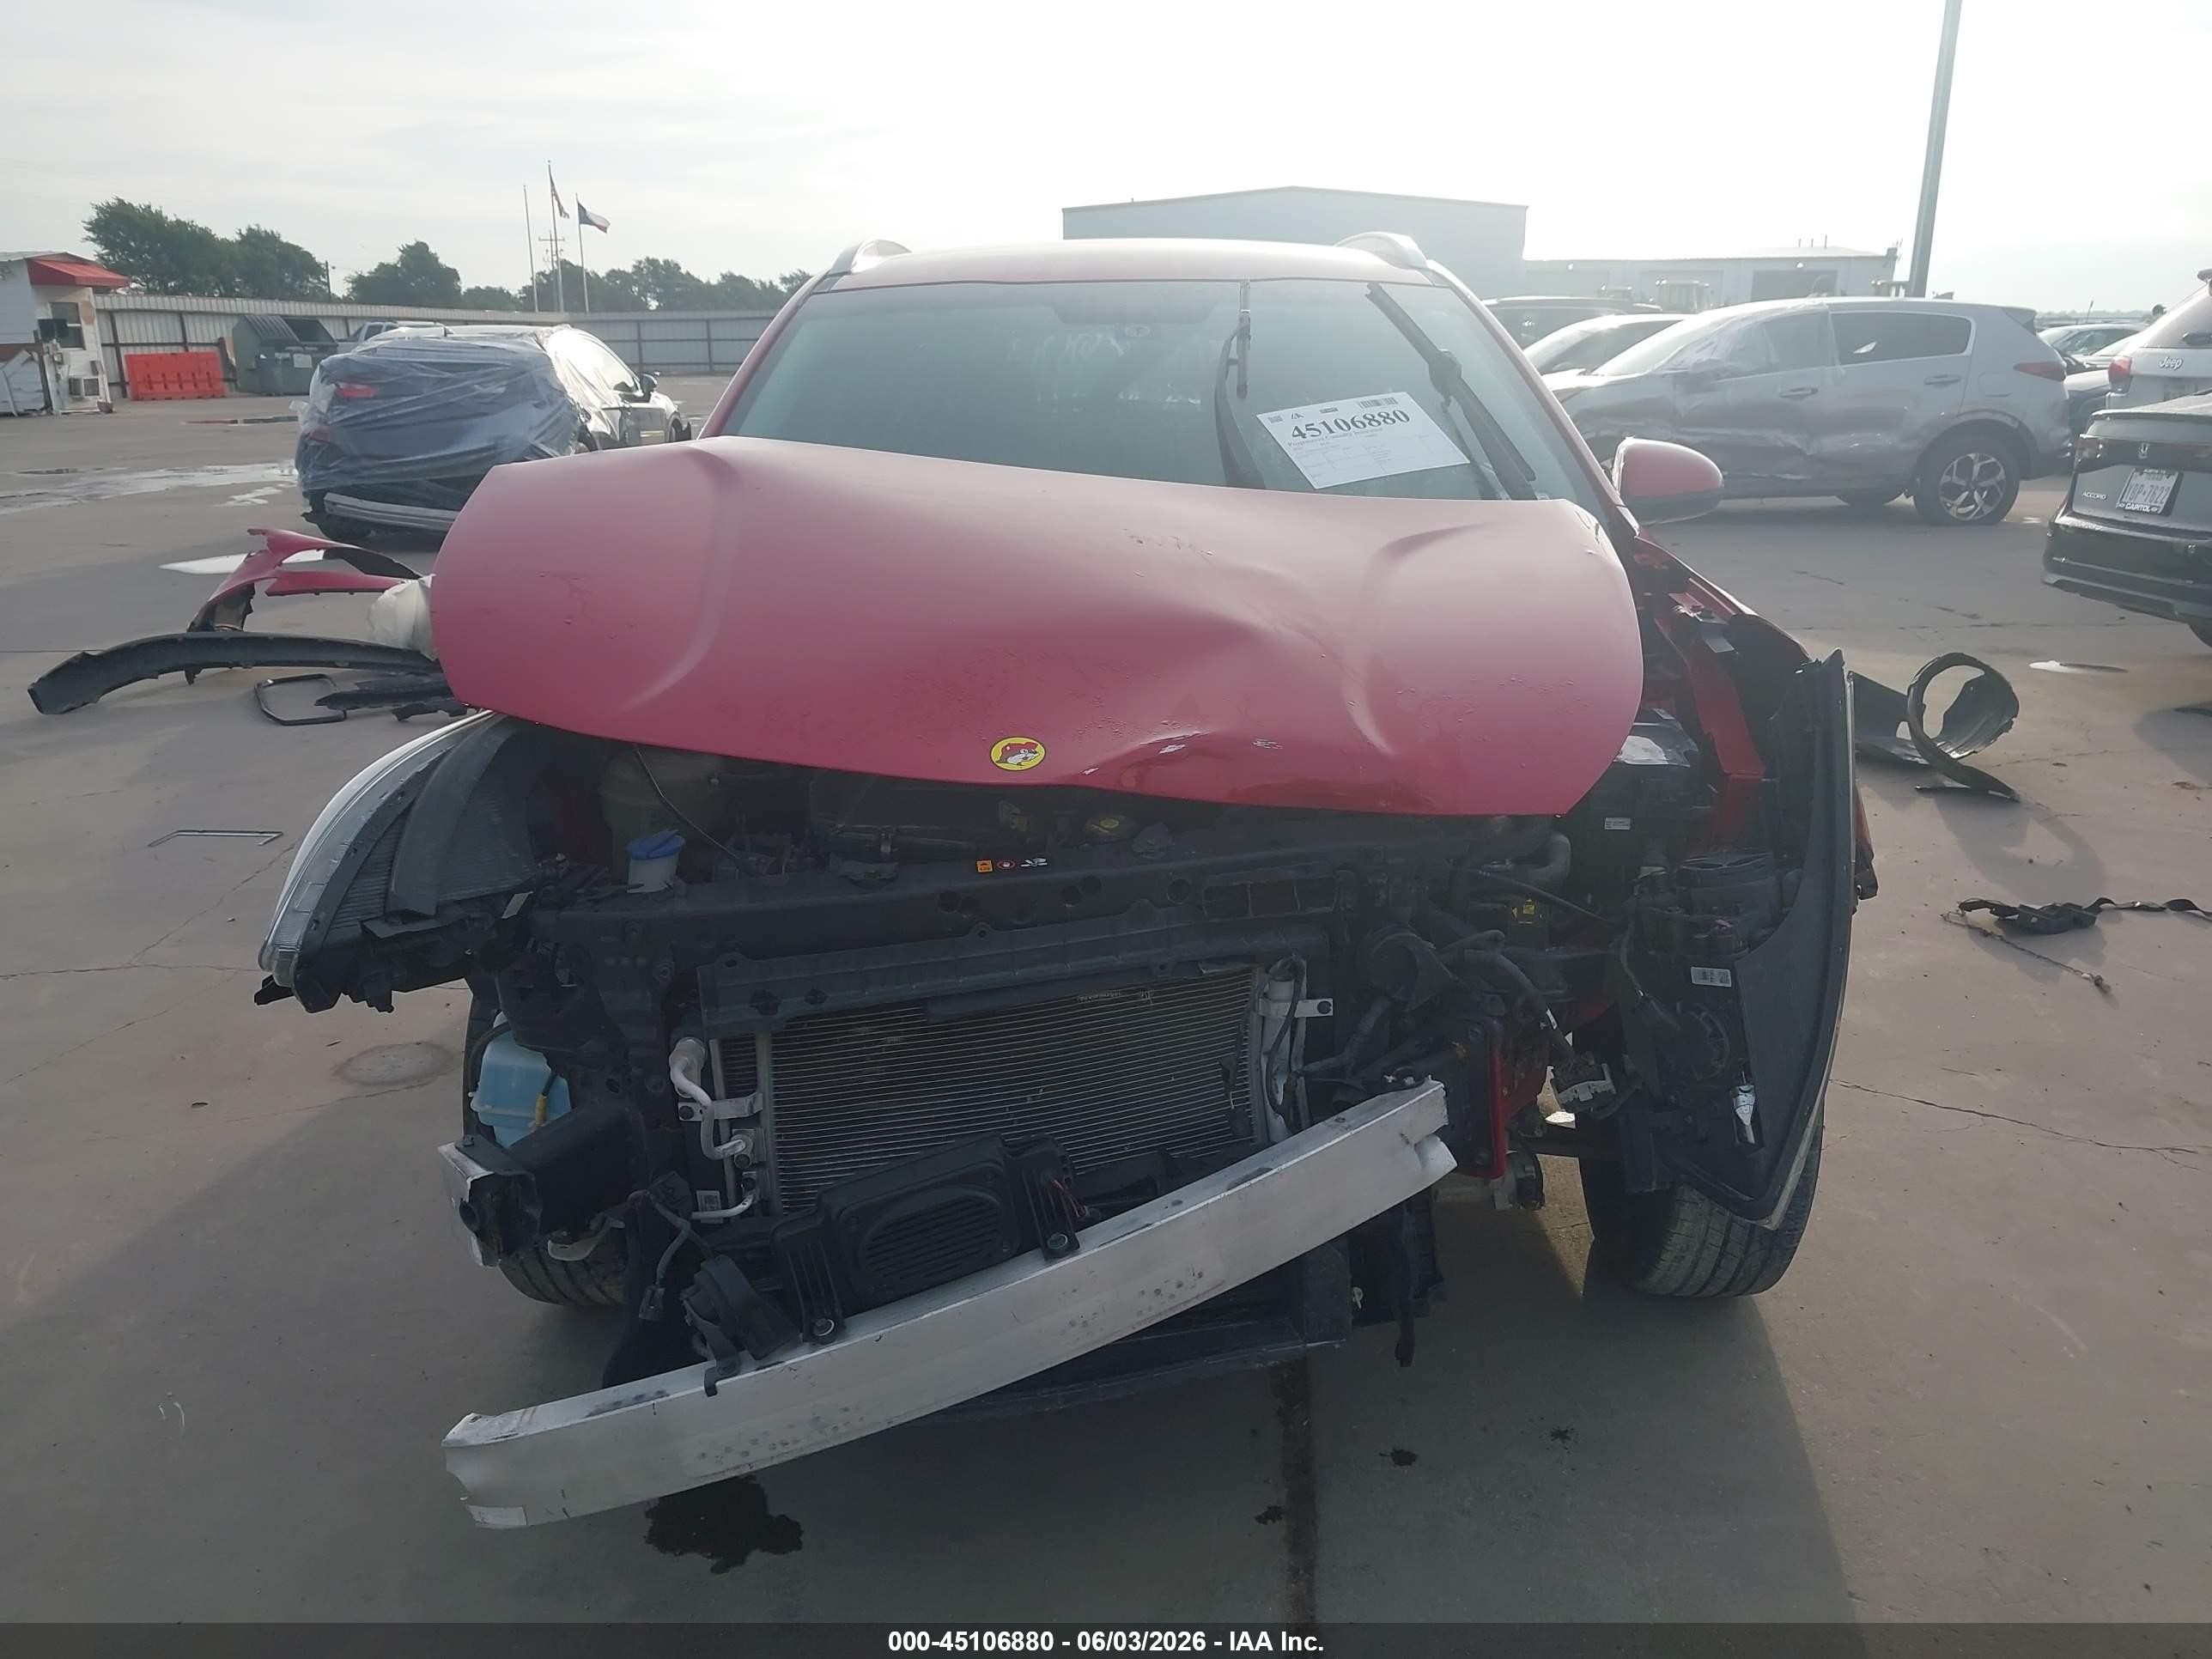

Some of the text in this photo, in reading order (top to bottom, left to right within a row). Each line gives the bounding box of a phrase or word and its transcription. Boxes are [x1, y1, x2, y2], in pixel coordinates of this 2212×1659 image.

[2159, 356, 2183, 371] Jeep
[1291, 410, 1410, 439] 45106880
[2125, 503, 2151, 513] CAPITOL
